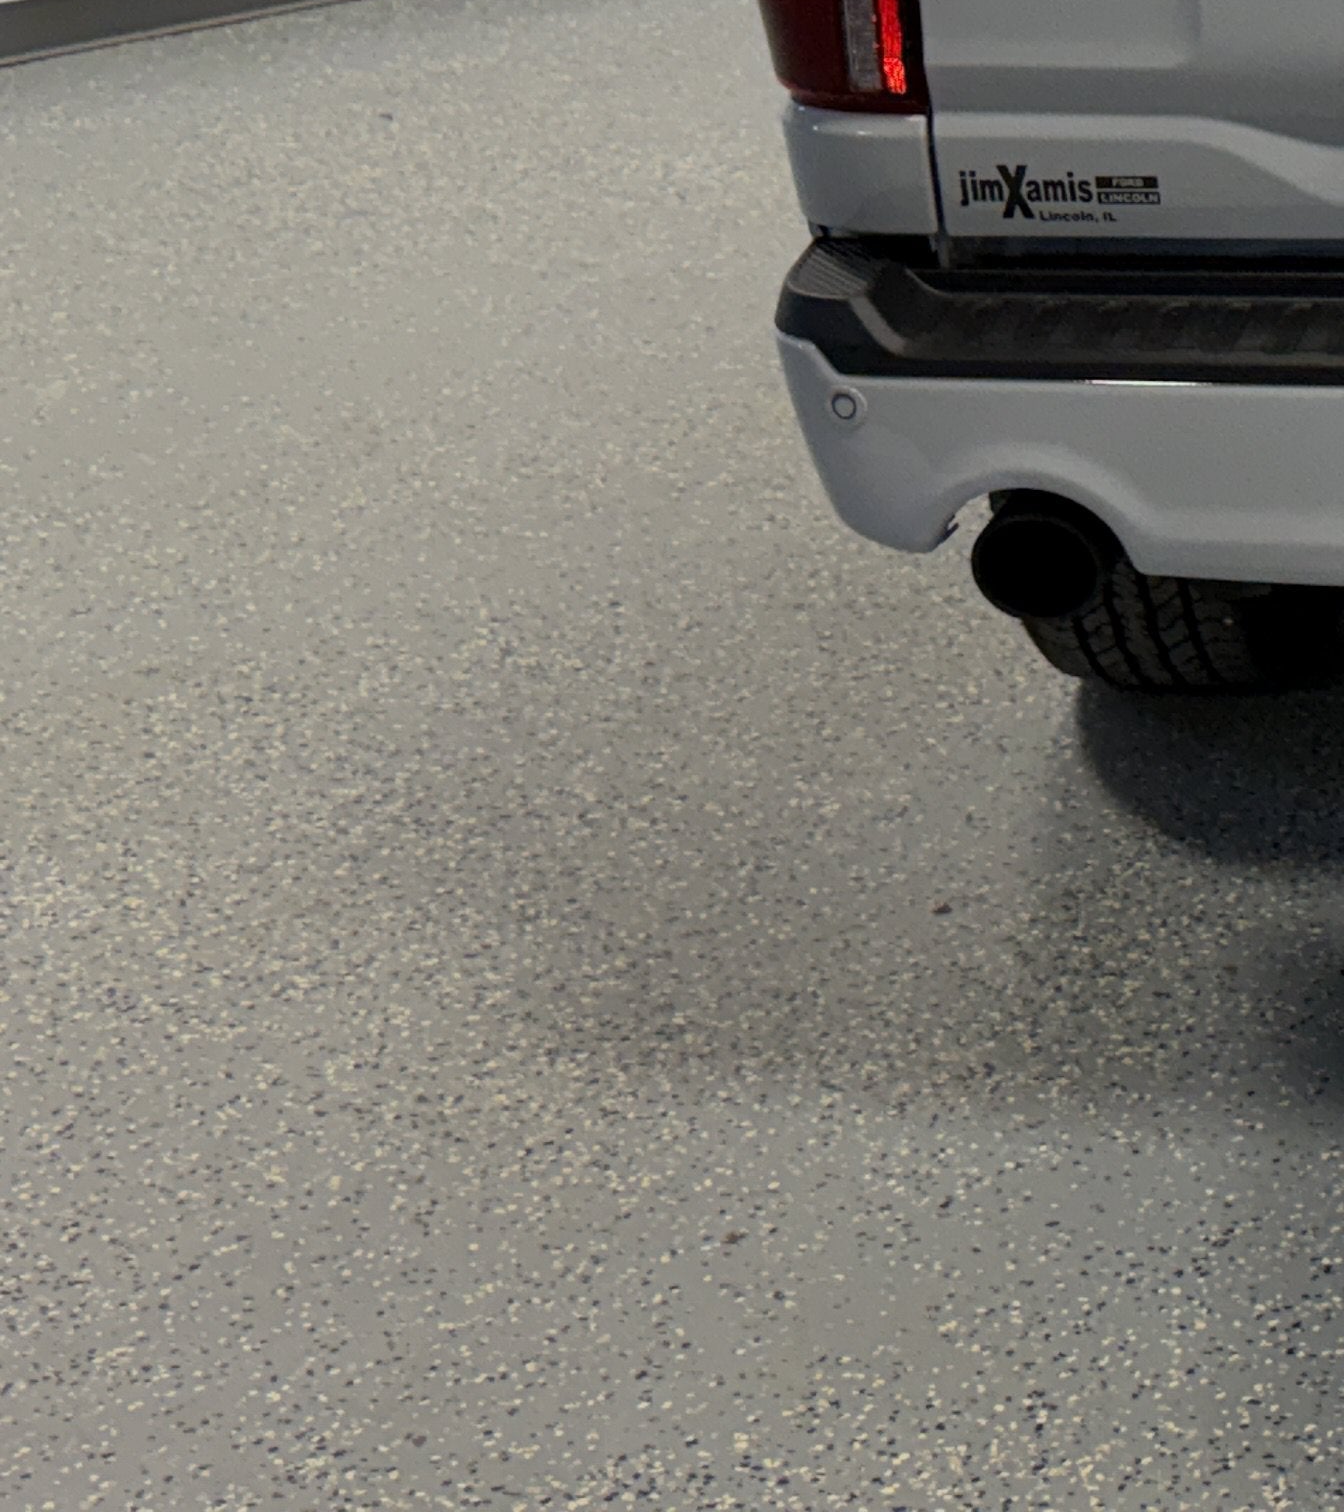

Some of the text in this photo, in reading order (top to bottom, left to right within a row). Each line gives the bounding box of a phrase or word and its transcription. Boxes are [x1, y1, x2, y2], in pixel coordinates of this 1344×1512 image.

[1100, 193, 1159, 204] LINCOLN
[1039, 210, 1117, 224] Lincoln, IL
